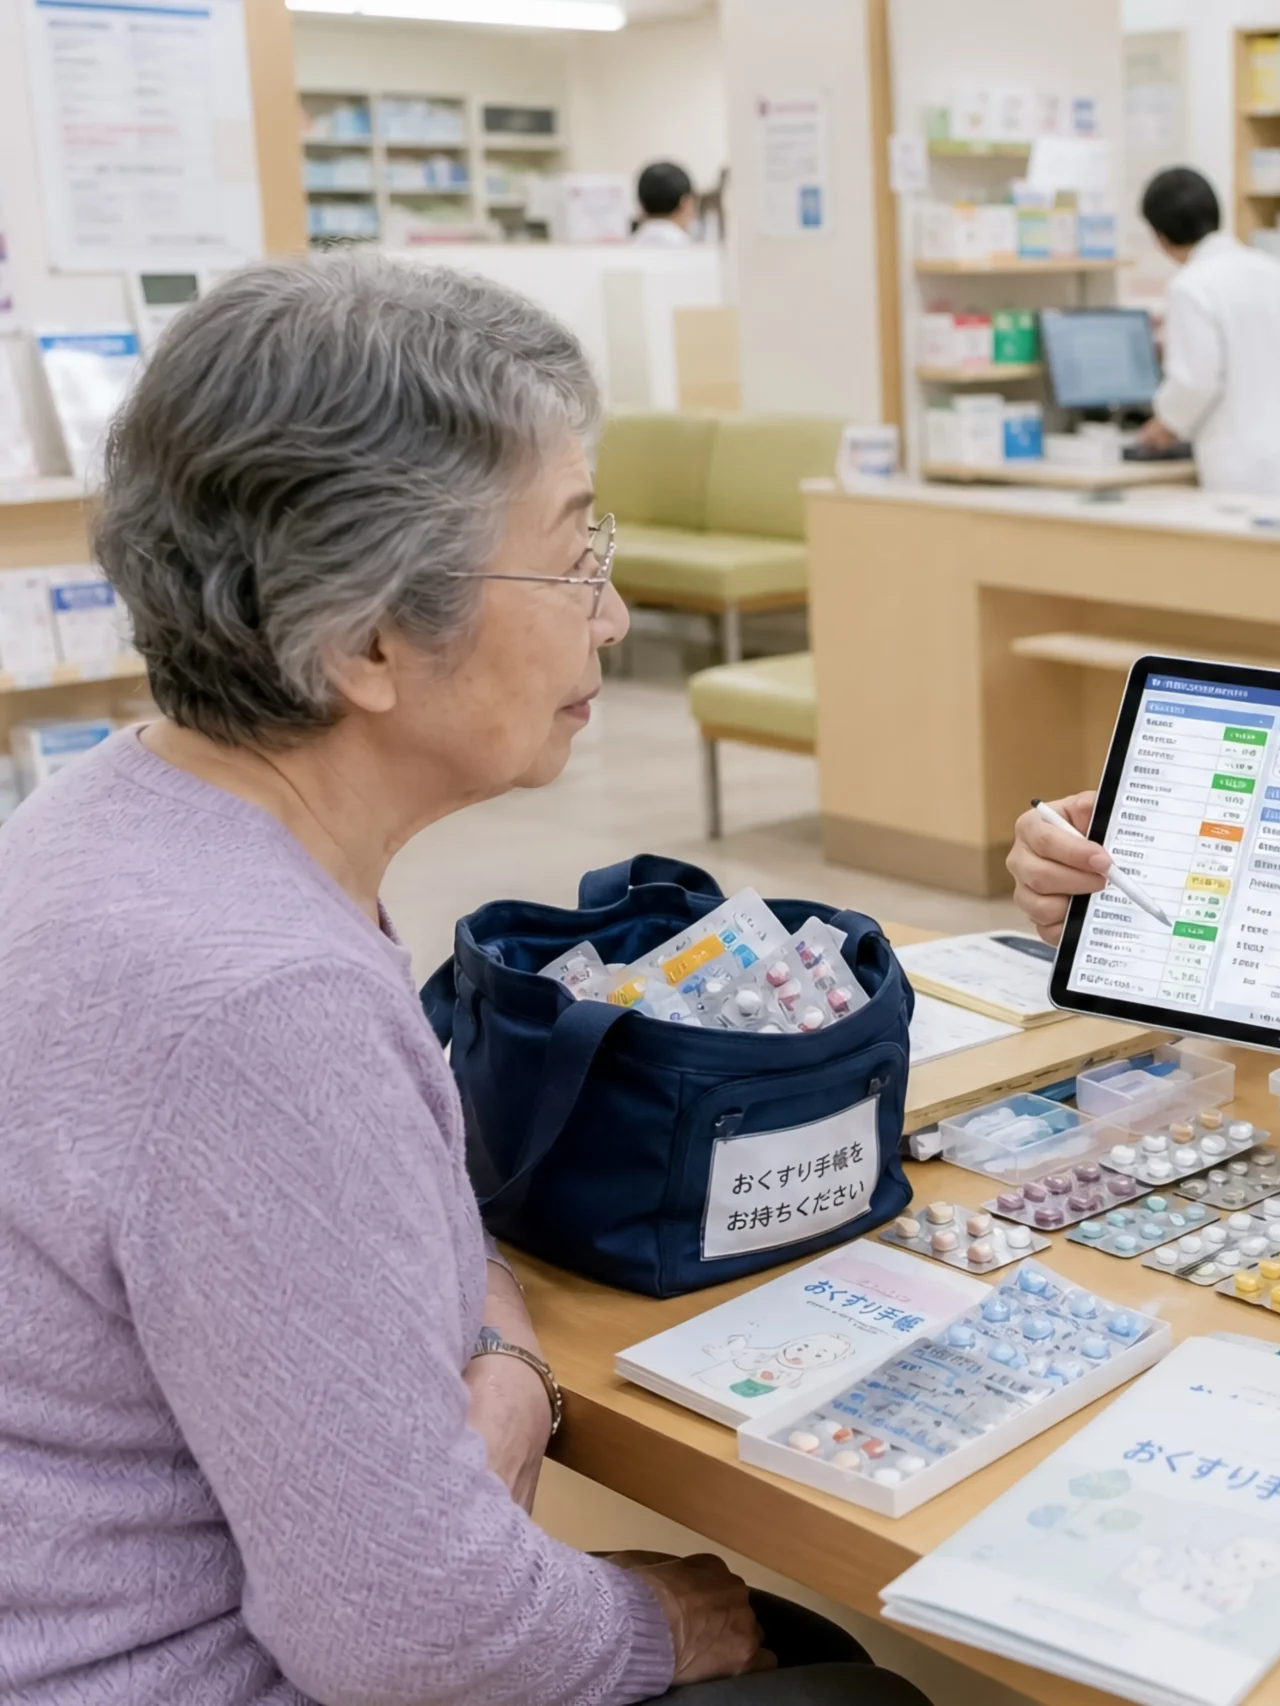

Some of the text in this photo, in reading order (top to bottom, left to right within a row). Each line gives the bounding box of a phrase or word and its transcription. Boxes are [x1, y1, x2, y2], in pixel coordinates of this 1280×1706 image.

[732, 1141, 864, 1195] おくすり手帳を
[727, 1180, 865, 1231] お持ちください
[804, 1280, 925, 1333] おくすり手帳
